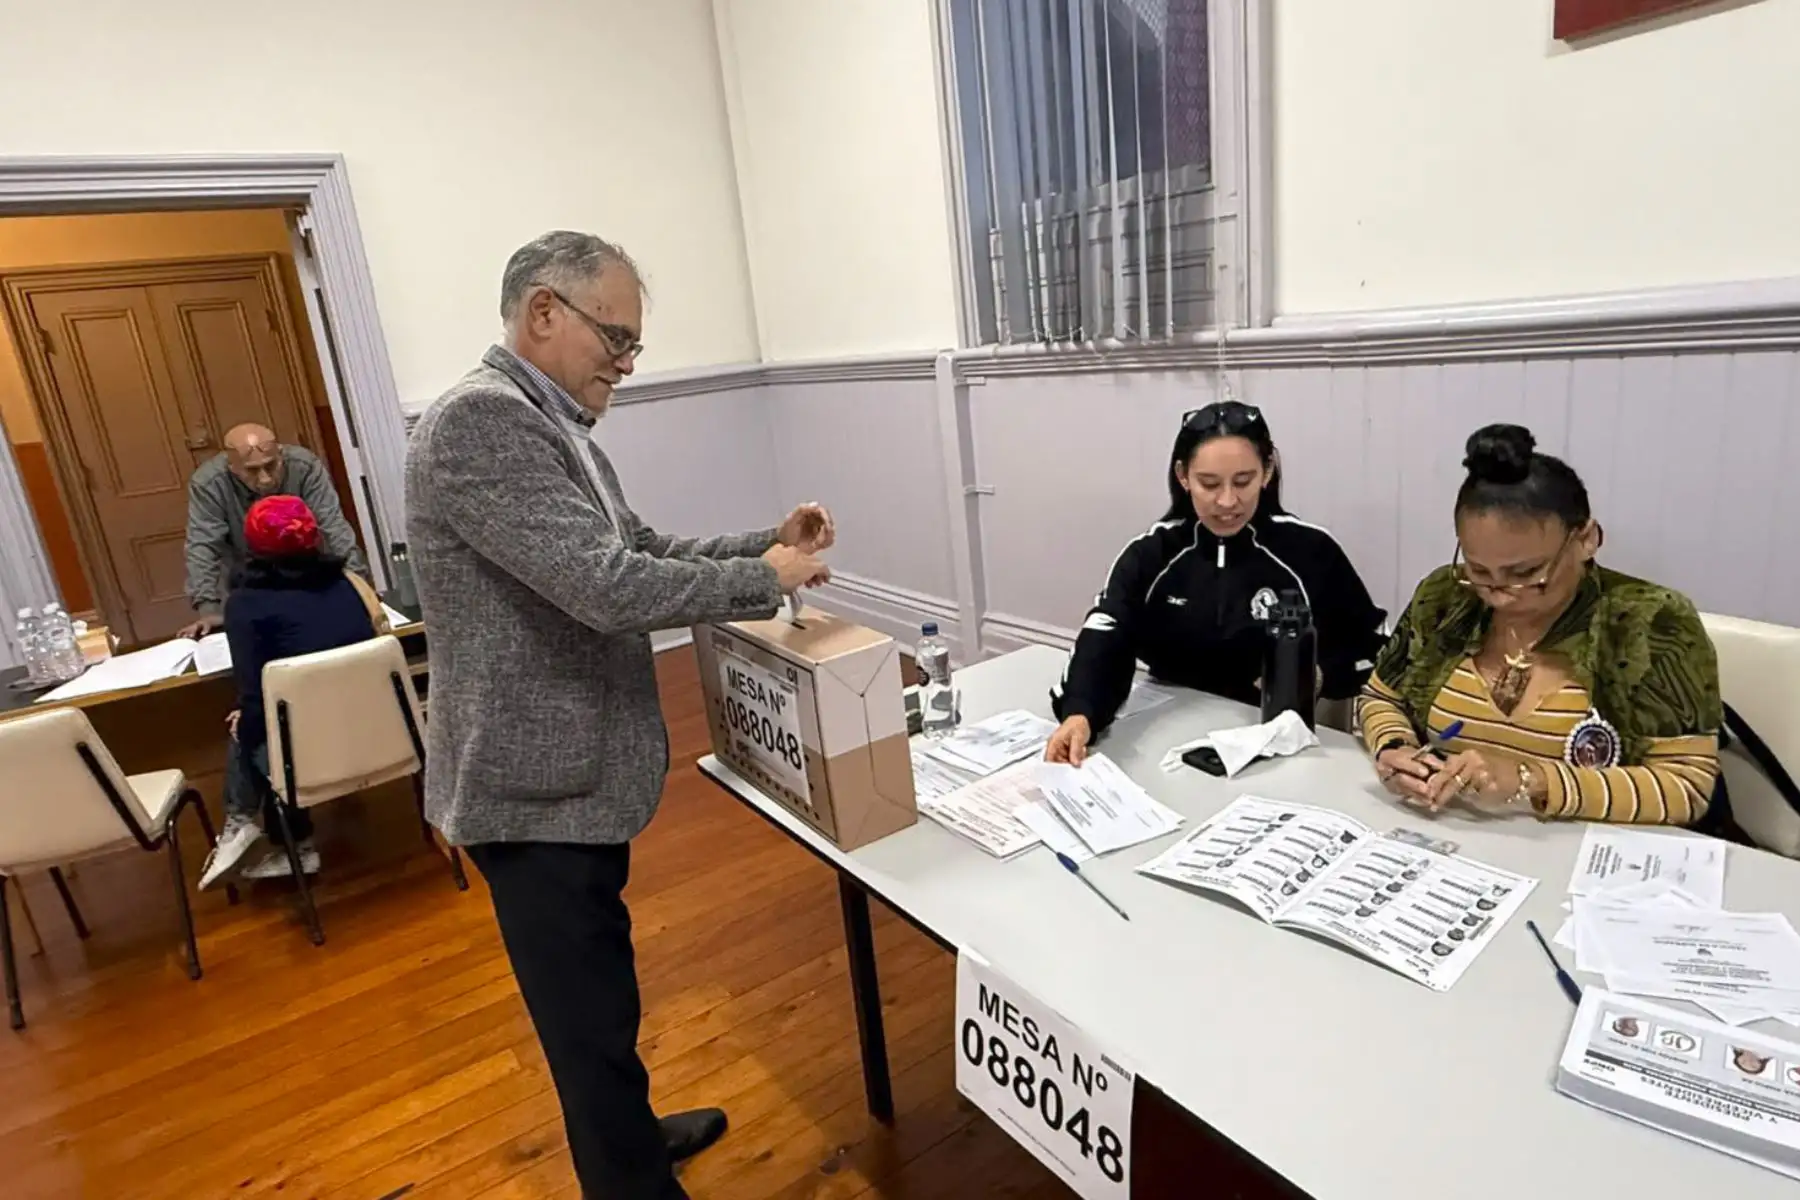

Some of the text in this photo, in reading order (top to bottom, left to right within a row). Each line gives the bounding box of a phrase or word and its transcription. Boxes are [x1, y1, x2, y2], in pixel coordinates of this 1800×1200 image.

[726, 666, 768, 708] MESA
[768, 688, 786, 715] Nº
[726, 696, 802, 770] 088048
[979, 982, 1064, 1074] MESA
[1072, 1053, 1108, 1098] Nº
[962, 1018, 1124, 1184] 088048
[1640, 1076, 1764, 1119] VICEPRESIDENTES
[1664, 1089, 1751, 1121] PRESIDENTE
[1769, 1116, 1778, 1124] Y
